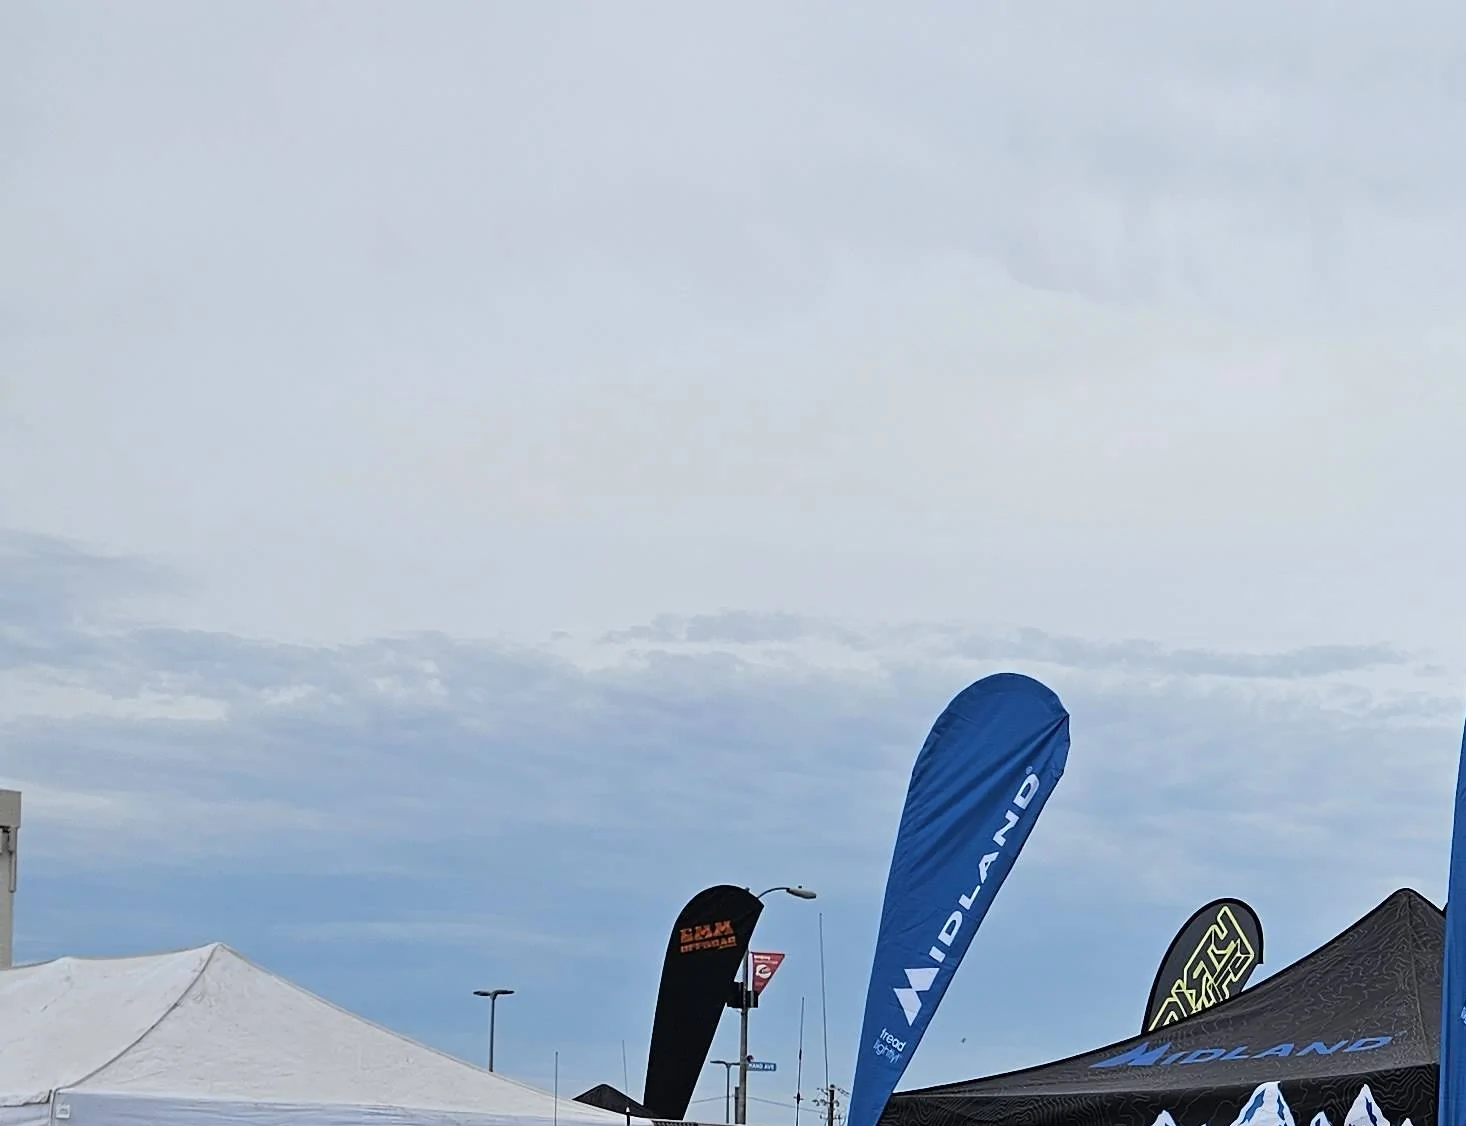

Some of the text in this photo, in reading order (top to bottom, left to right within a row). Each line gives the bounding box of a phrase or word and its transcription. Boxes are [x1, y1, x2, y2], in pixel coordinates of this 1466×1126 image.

[893, 773, 1040, 1027] MIDLAND
[880, 1027, 906, 1052] tread
[1089, 1036, 1393, 1068] MIDLAND
[763, 1063, 775, 1071] AVE
